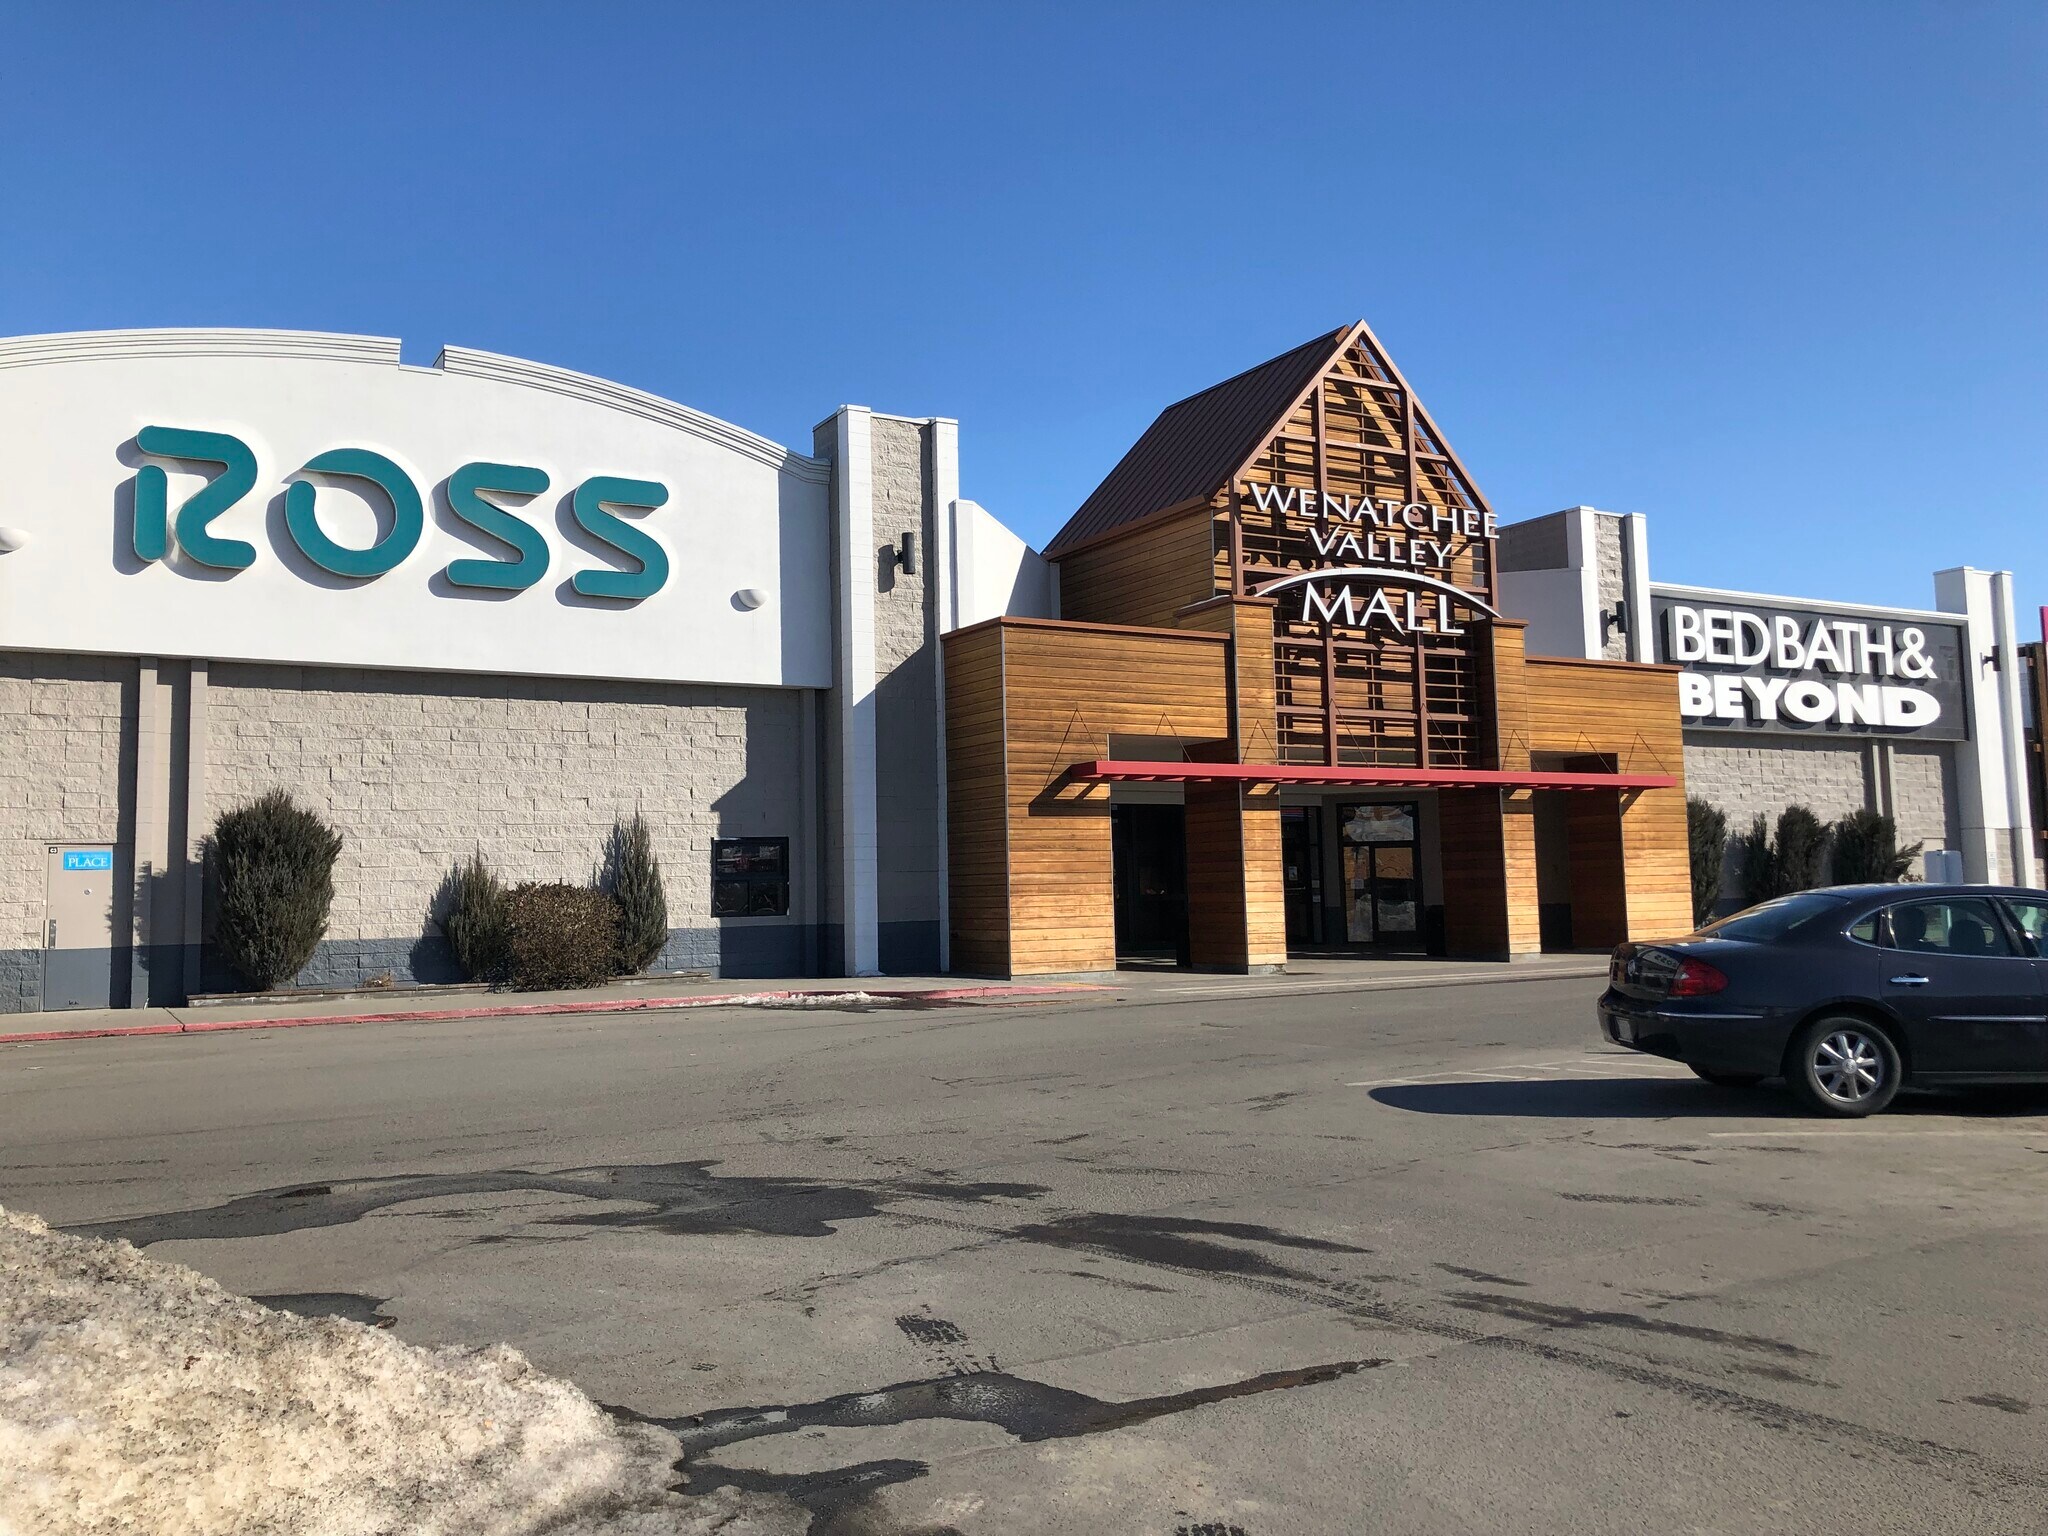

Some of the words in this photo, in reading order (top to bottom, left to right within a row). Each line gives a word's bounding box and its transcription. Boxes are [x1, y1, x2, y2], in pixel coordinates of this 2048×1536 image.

[134, 425, 669, 599] ROSS
[1251, 482, 1500, 539] WENATCHEE
[1309, 524, 1452, 567] VALLEY
[1302, 581, 1465, 636] MALL
[1674, 605, 1771, 666] BED
[1774, 615, 1894, 676] BATH
[1899, 627, 1938, 679] &
[1678, 671, 1941, 727] BEYOND
[68, 857, 108, 867] PLACE
